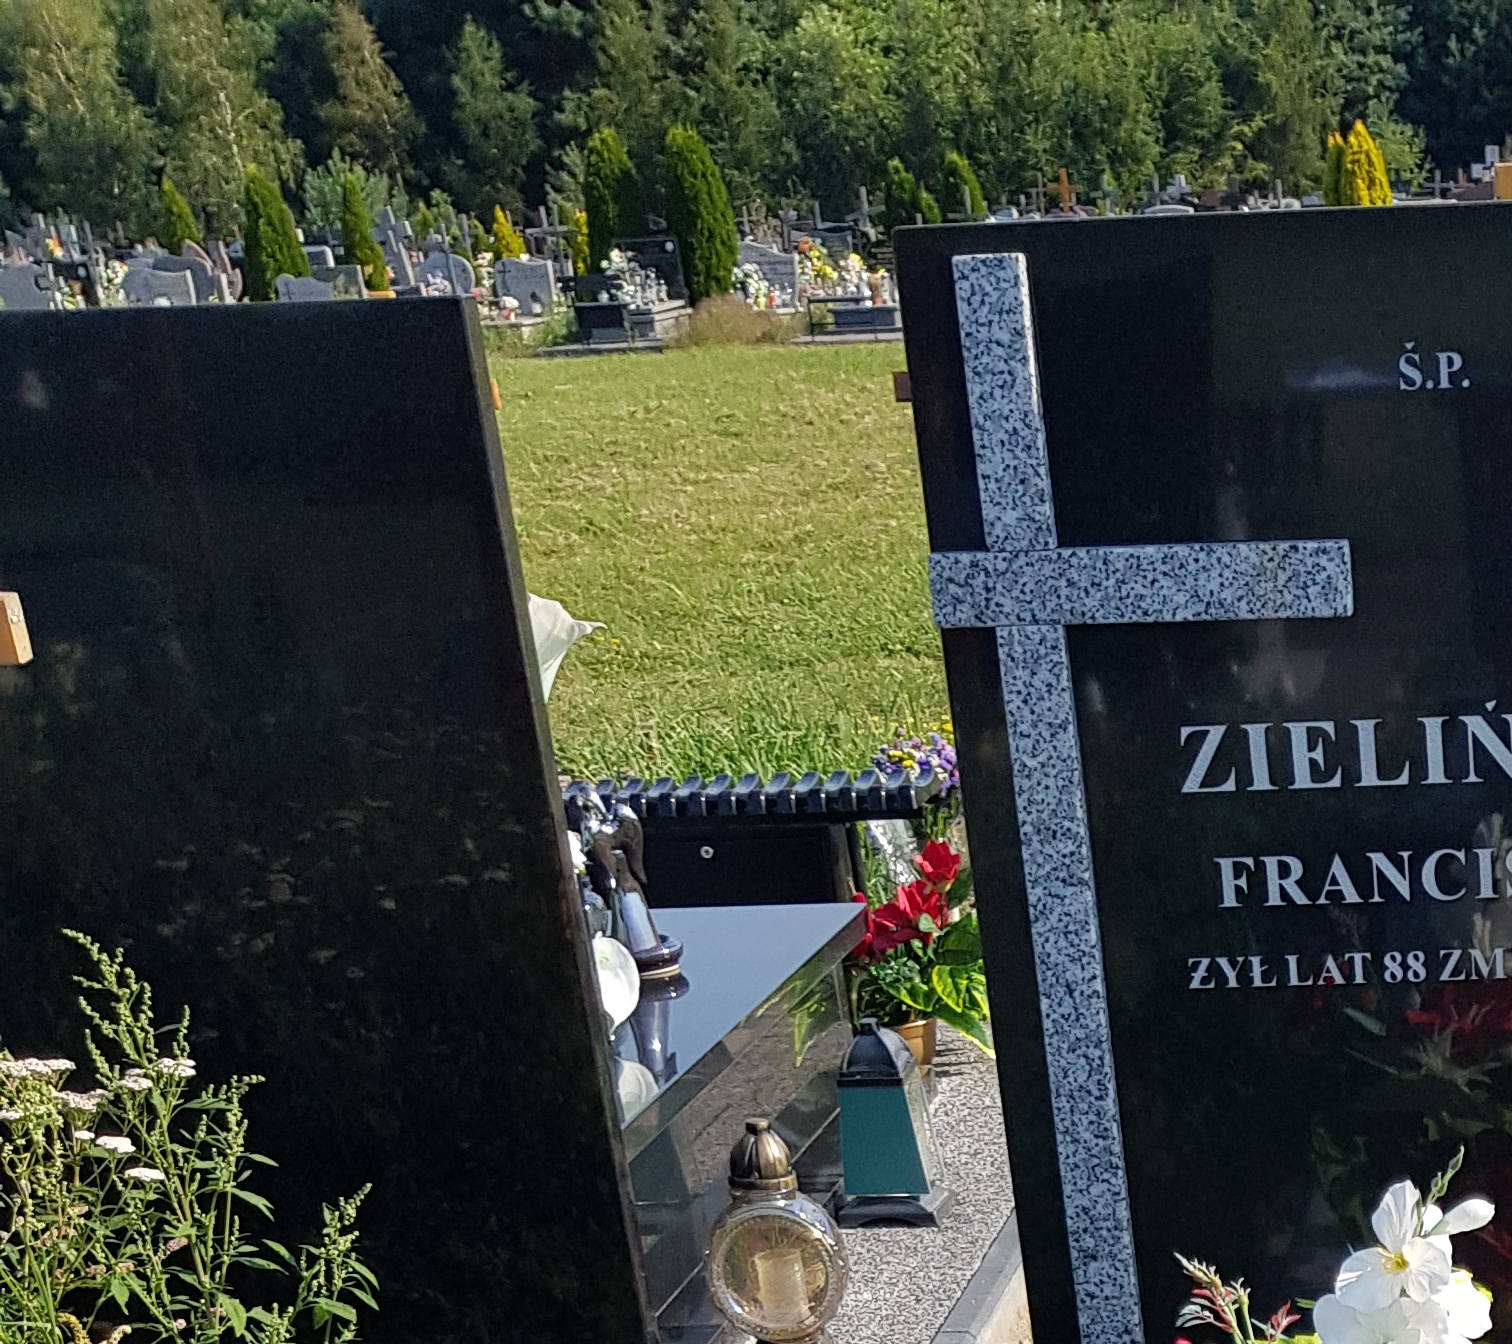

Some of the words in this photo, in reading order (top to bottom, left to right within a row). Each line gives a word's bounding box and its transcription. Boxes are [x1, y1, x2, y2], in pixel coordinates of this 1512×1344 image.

[1398, 341, 1471, 391] Ś.P.
[1284, 951, 1373, 987] LAT
[1383, 949, 1427, 984] 88
